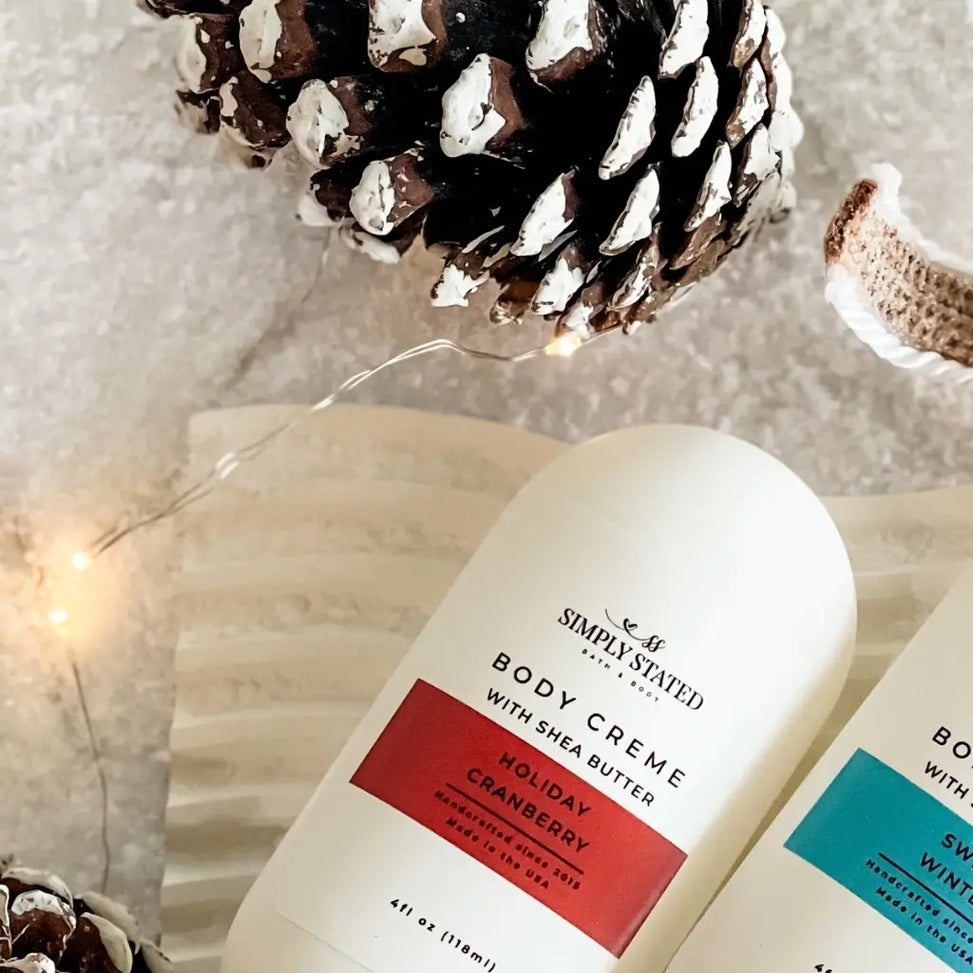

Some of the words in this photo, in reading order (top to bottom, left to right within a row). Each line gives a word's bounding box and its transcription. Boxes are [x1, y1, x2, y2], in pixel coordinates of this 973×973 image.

[558, 608, 632, 661] SIMPLY
[629, 653, 704, 711] STATED
[488, 688, 532, 724] WITH
[536, 720, 582, 758] SHEA
[588, 755, 655, 807] BUTTER
[492, 652, 576, 711] BODY
[587, 712, 685, 788] CREME
[467, 768, 590, 853] CRANBERRY
[498, 752, 592, 817] HOLIDAY
[925, 762, 969, 799] WITH
[434, 791, 512, 845] Handcrafted
[516, 841, 549, 869] since
[553, 868, 581, 890] 2015
[446, 817, 479, 843] Made
[484, 841, 497, 853] in
[501, 853, 521, 870] the
[526, 869, 549, 889] USA
[390, 898, 411, 917] 4fl
[418, 916, 435, 932] oz
[441, 931, 497, 973] (118ml)
[866, 859, 941, 916] Handcrafted
[943, 916, 973, 944] since
[876, 887, 907, 913] Made
[911, 911, 924, 924] in
[927, 924, 947, 942] the
[951, 944, 973, 965] USA
